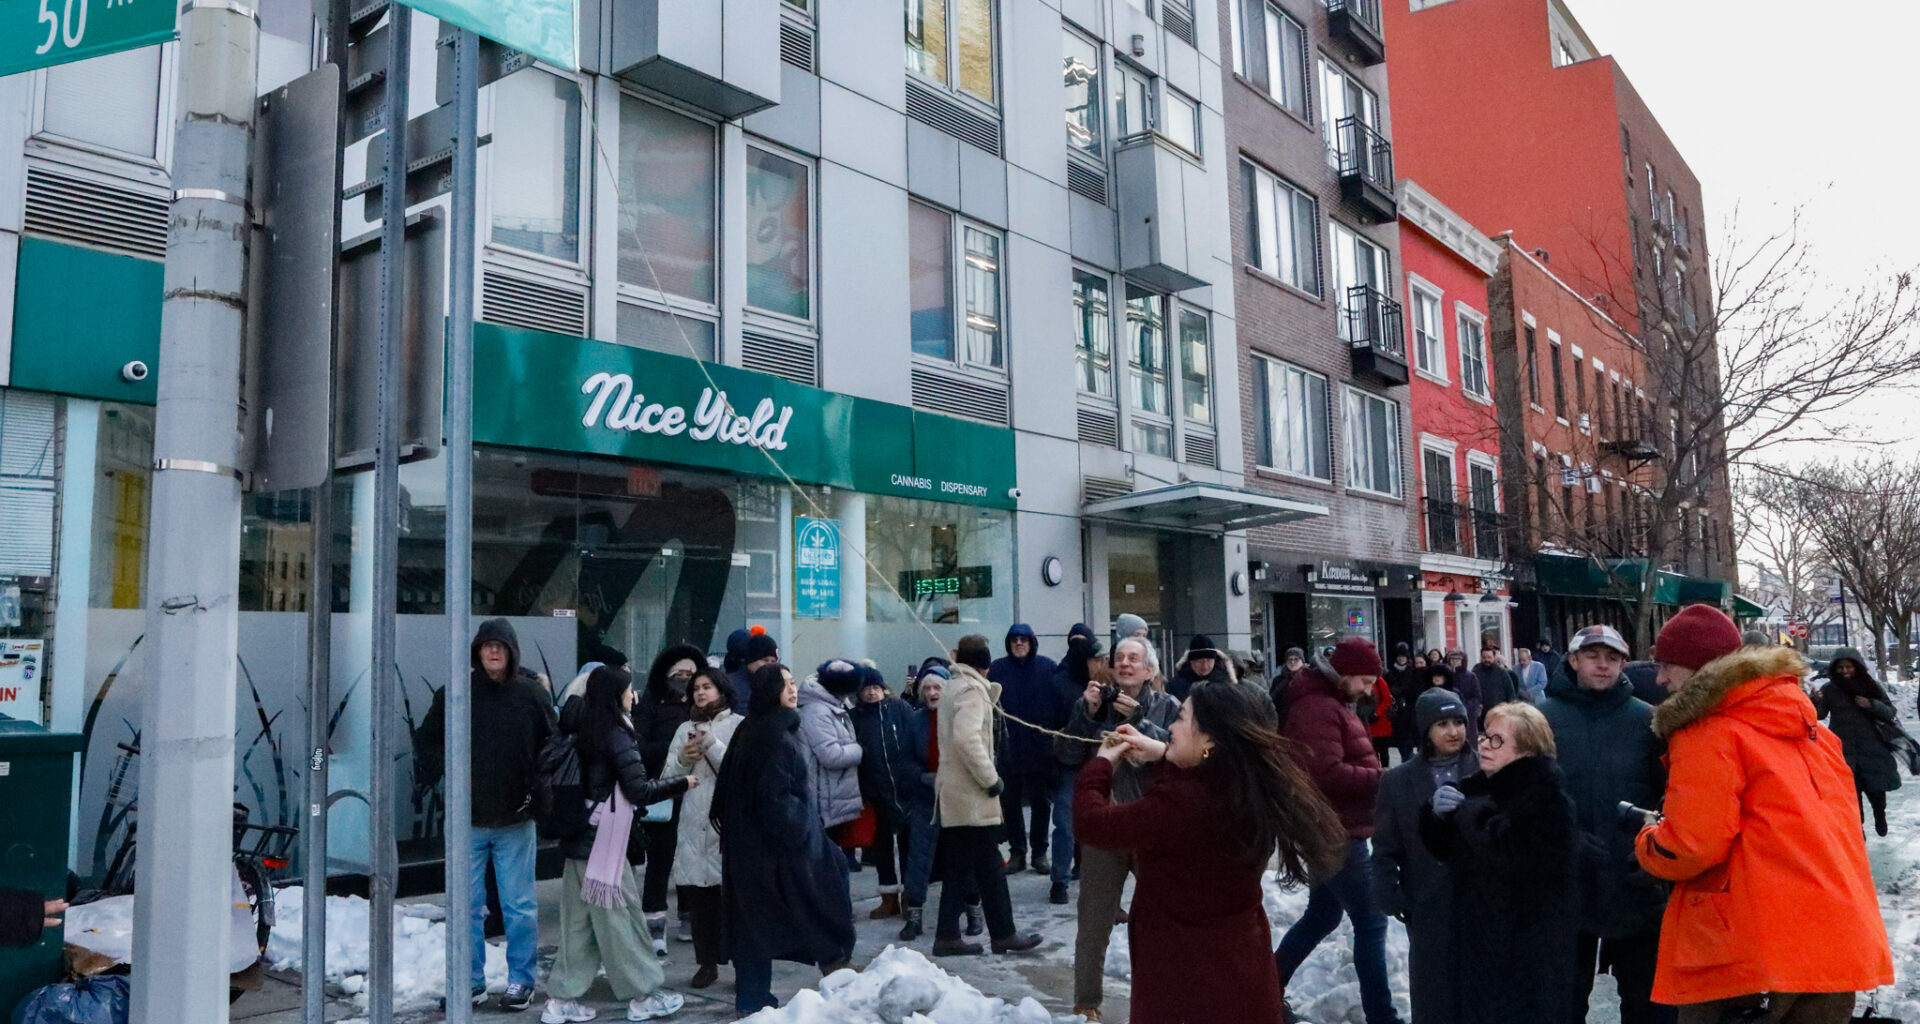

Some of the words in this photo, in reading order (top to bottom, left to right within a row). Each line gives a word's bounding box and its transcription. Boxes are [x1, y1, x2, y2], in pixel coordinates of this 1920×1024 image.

[35, 0, 88, 55] 50
[581, 372, 687, 436] Nice
[689, 387, 793, 450] Yield
[891, 473, 932, 490] CANNABIS
[940, 481, 988, 497] DISPENSARY
